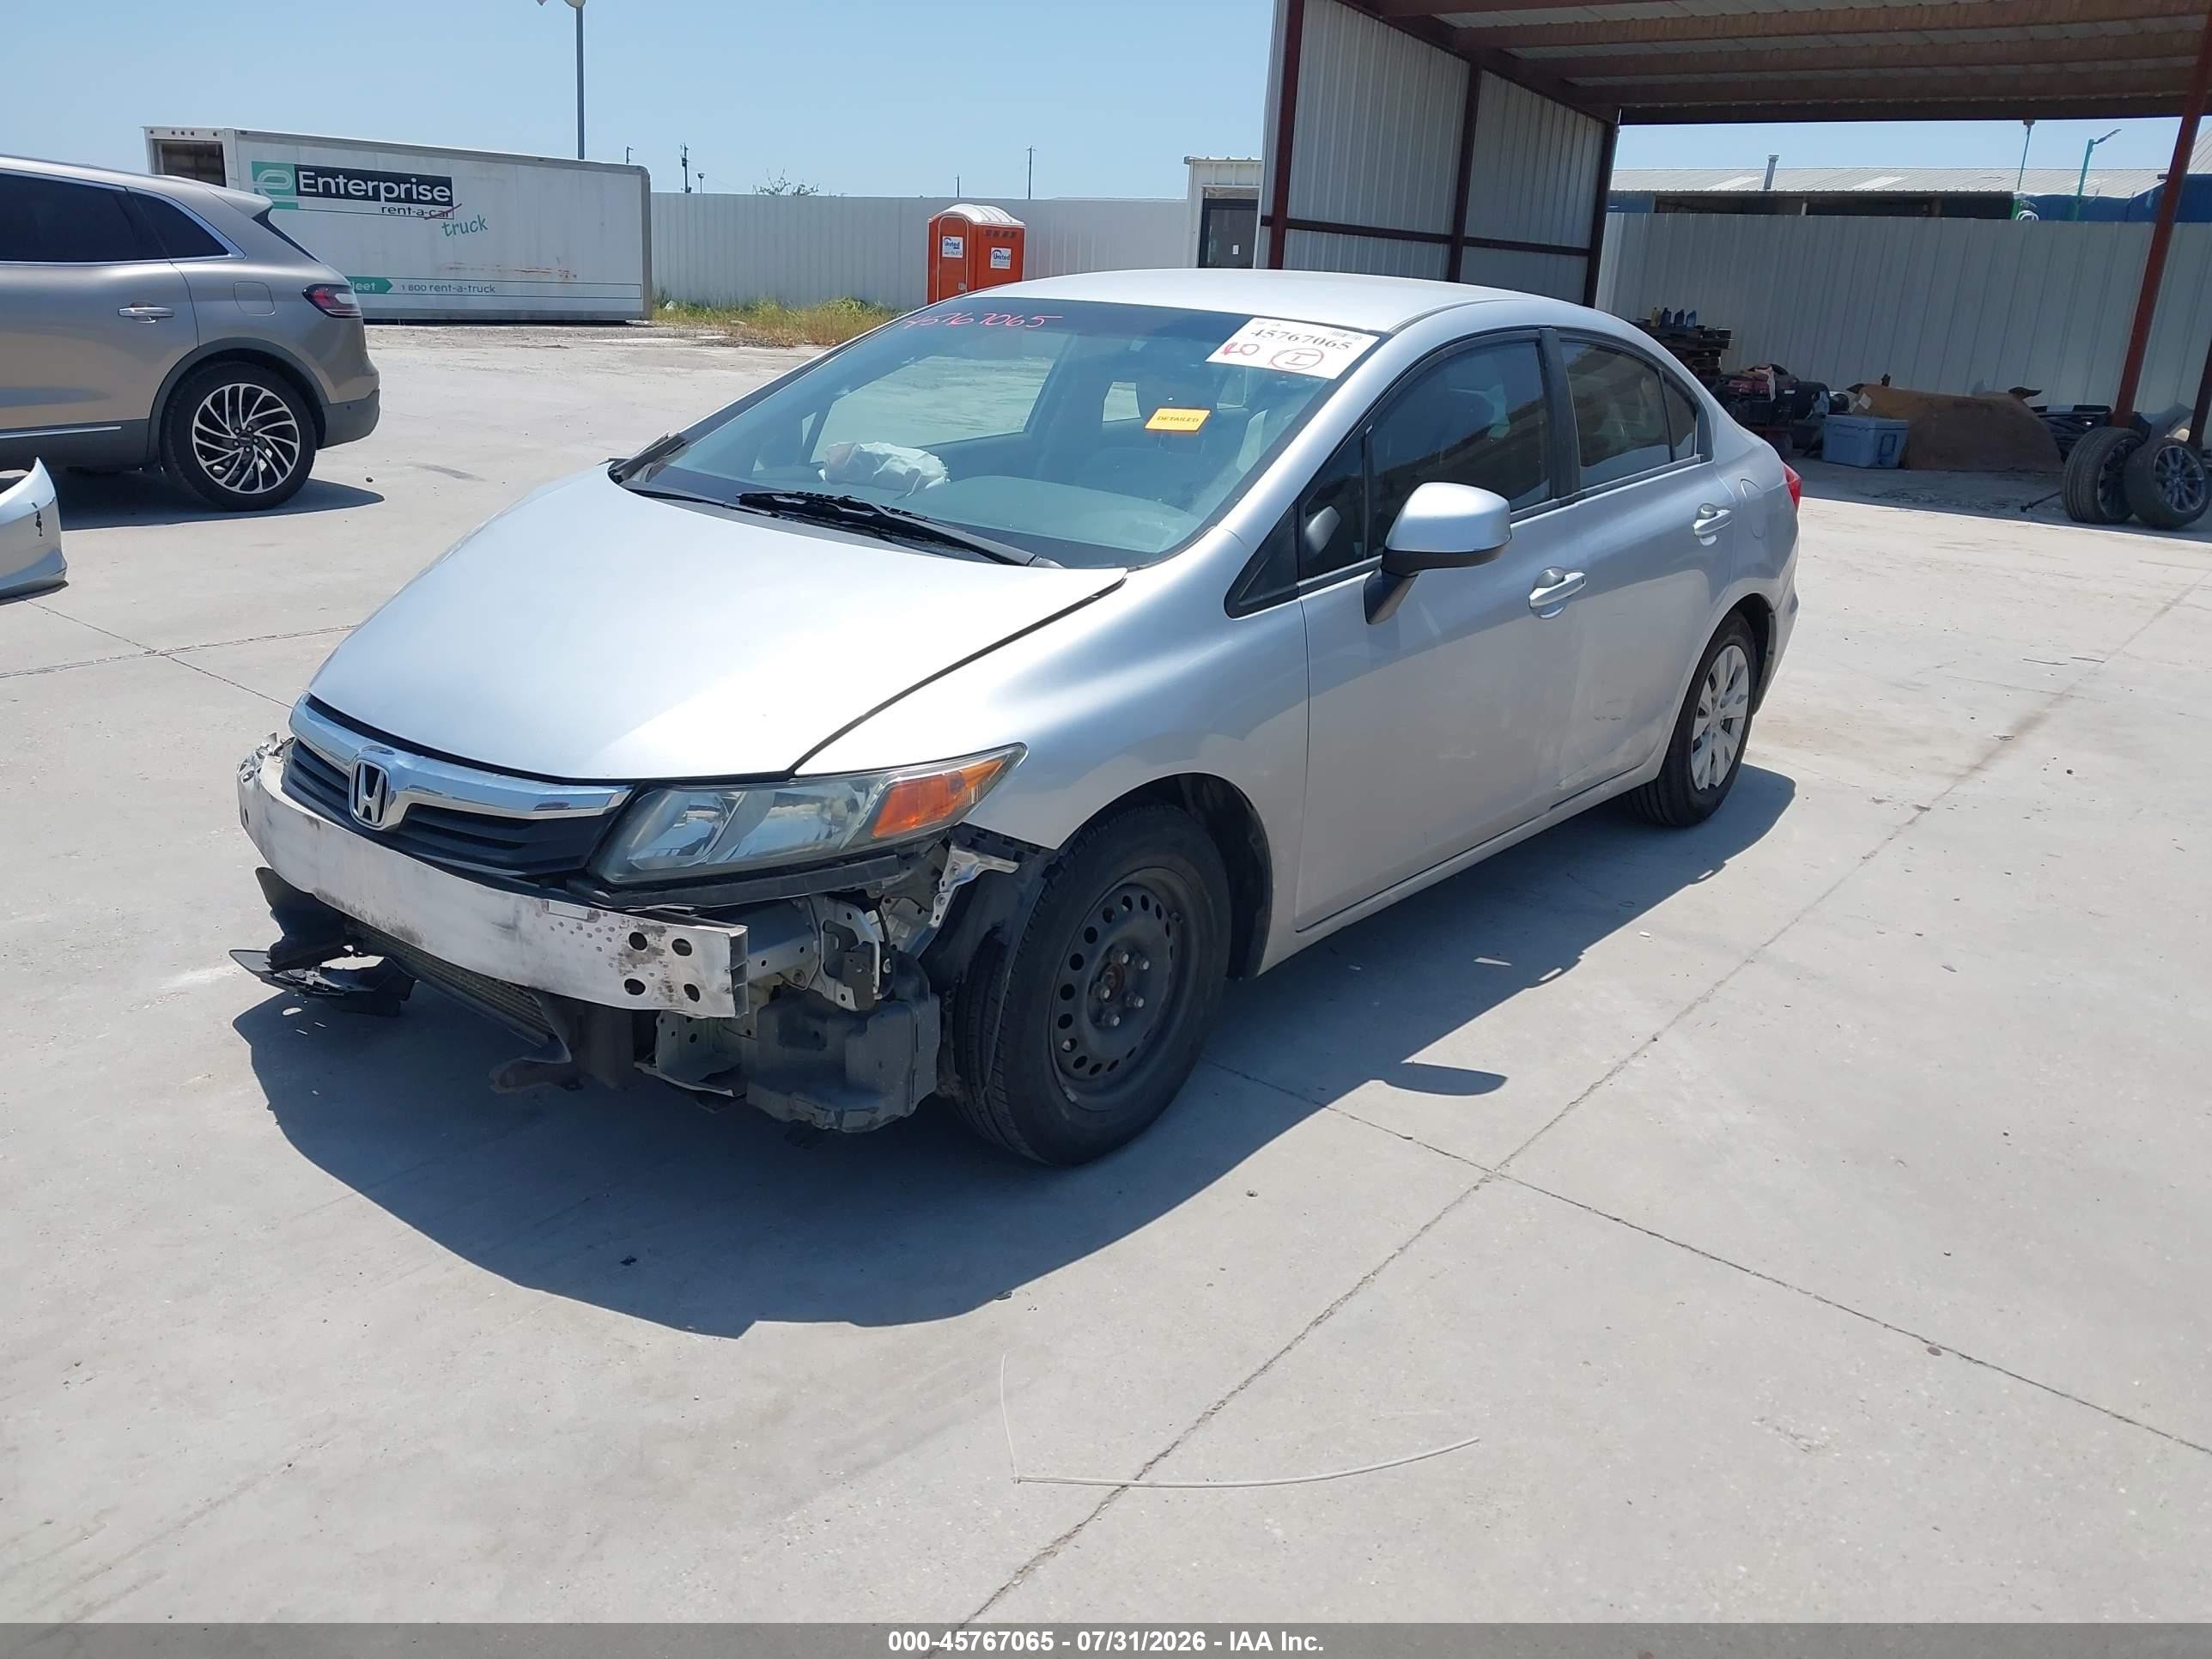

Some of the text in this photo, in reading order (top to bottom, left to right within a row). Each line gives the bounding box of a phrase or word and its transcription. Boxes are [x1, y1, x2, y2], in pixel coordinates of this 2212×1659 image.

[298, 170, 451, 202] Enterprise
[380, 204, 451, 219] rent-a-car
[441, 214, 489, 237] truck
[993, 252, 1011, 261] United
[350, 281, 376, 292] leet
[408, 284, 428, 293] 800
[429, 283, 496, 294] rent-a-truck
[1250, 328, 1353, 351] 45767065
